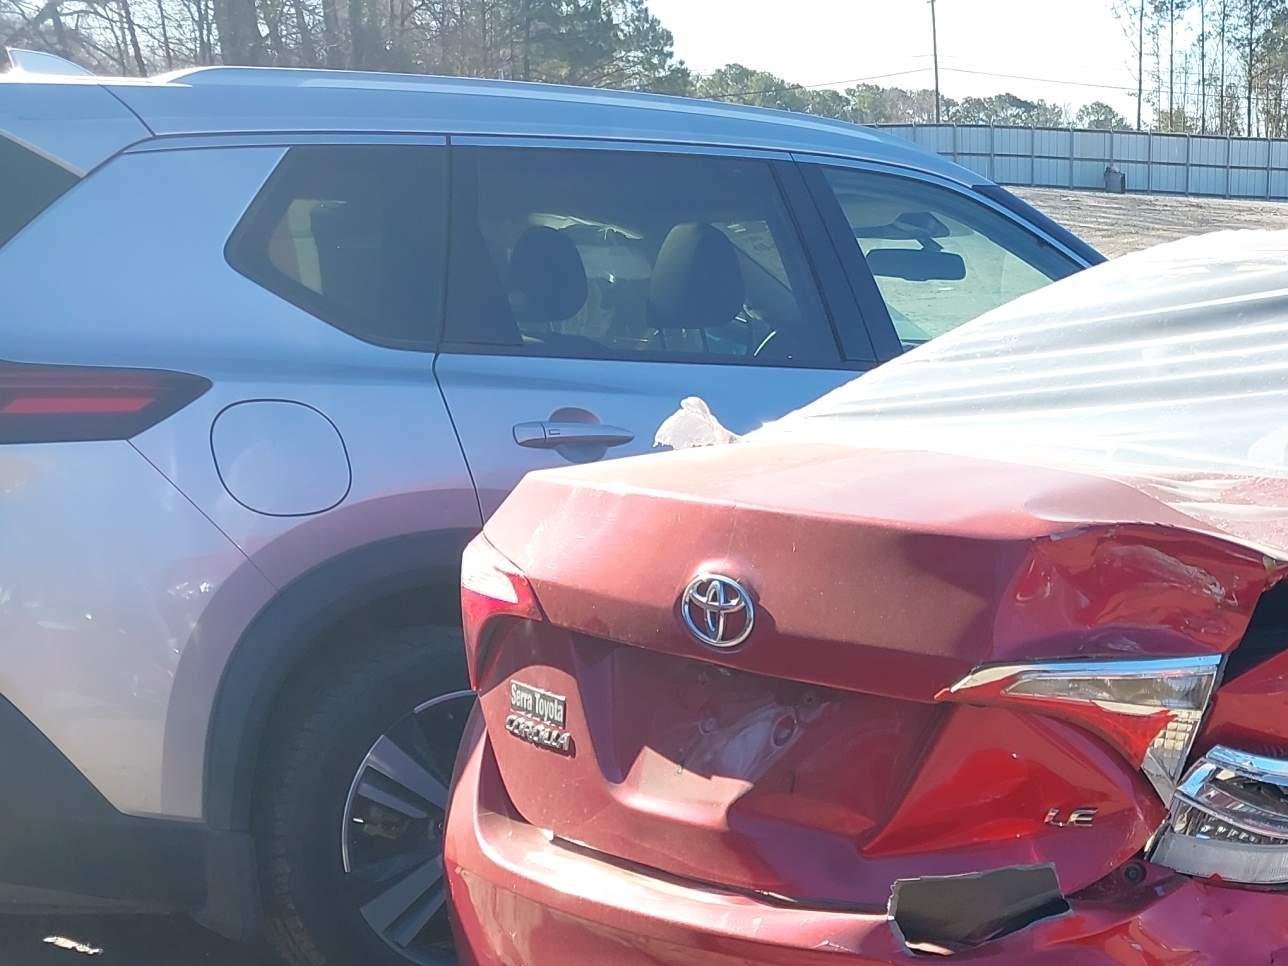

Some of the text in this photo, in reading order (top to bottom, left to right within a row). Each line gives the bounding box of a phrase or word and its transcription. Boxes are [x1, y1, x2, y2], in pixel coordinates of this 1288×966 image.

[511, 683, 564, 722] Serra Toyota
[1044, 807, 1098, 827] LE
